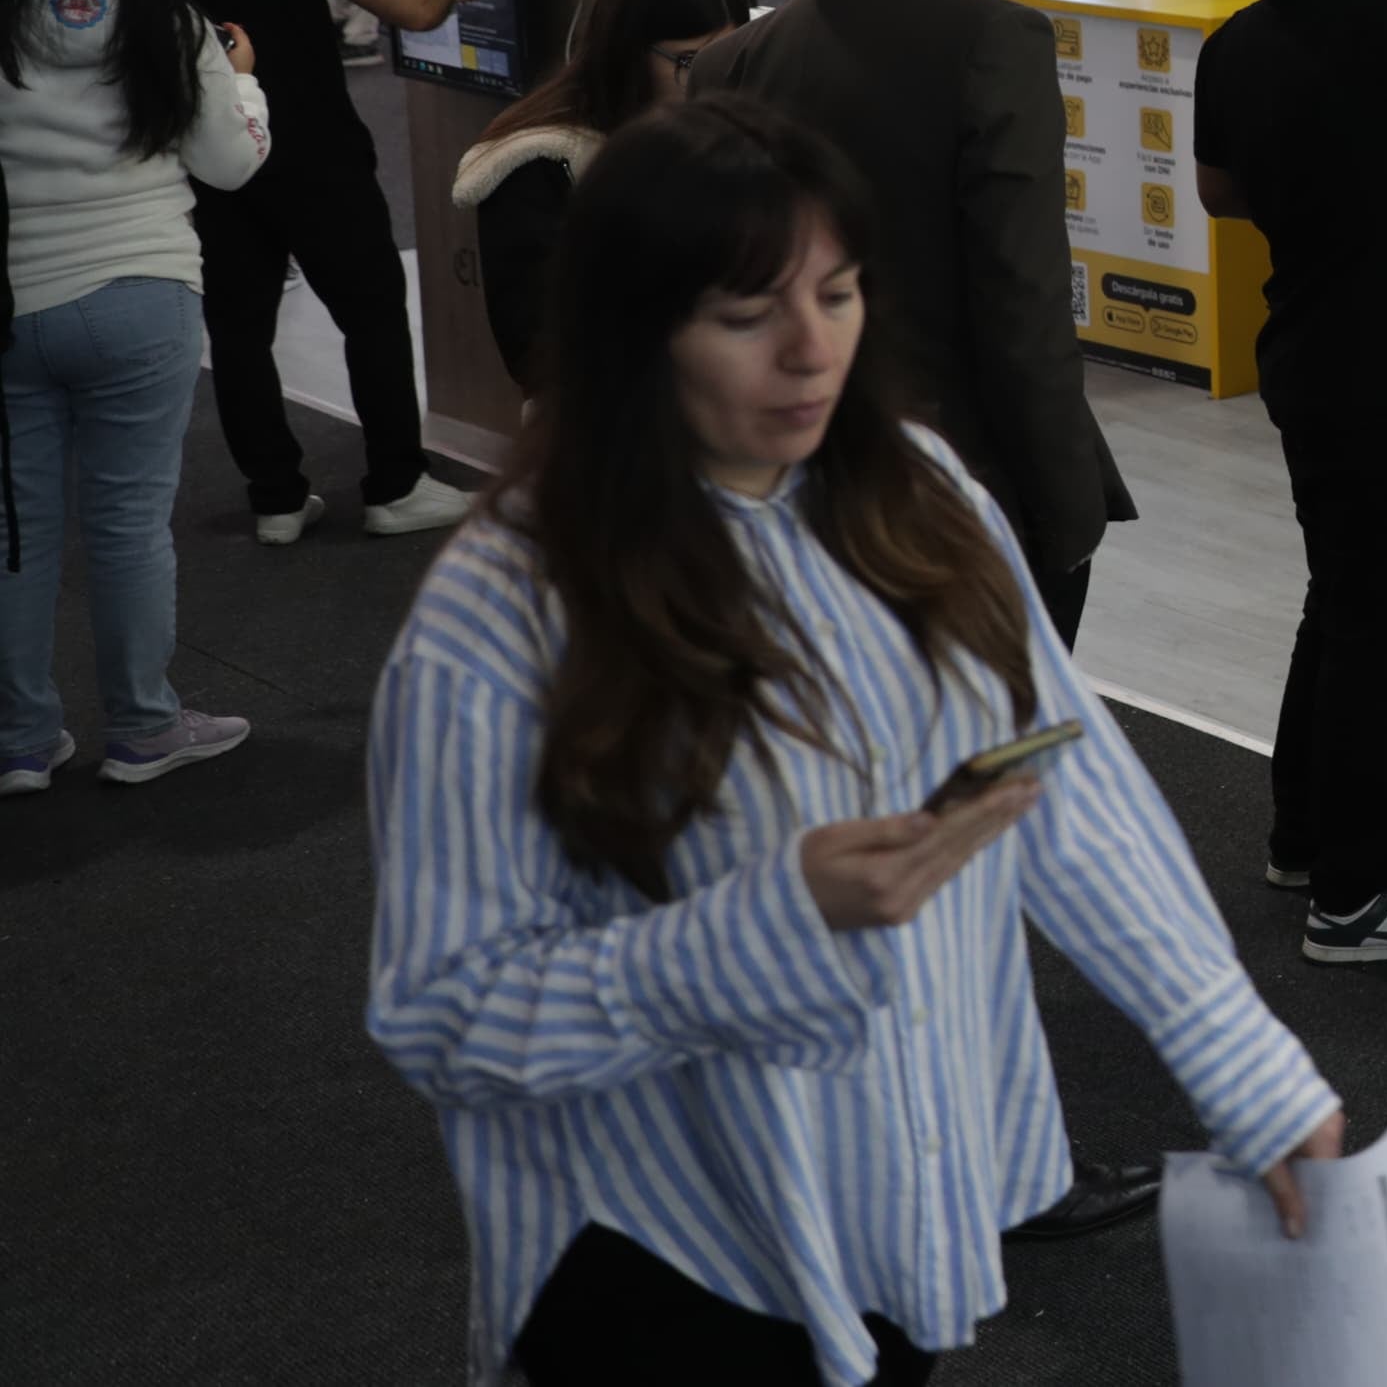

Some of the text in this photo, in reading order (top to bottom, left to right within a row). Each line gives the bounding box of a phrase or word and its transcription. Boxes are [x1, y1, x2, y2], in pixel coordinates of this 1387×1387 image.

[454, 248, 480, 287] El
[1111, 279, 1185, 308] Descárgala gratis
